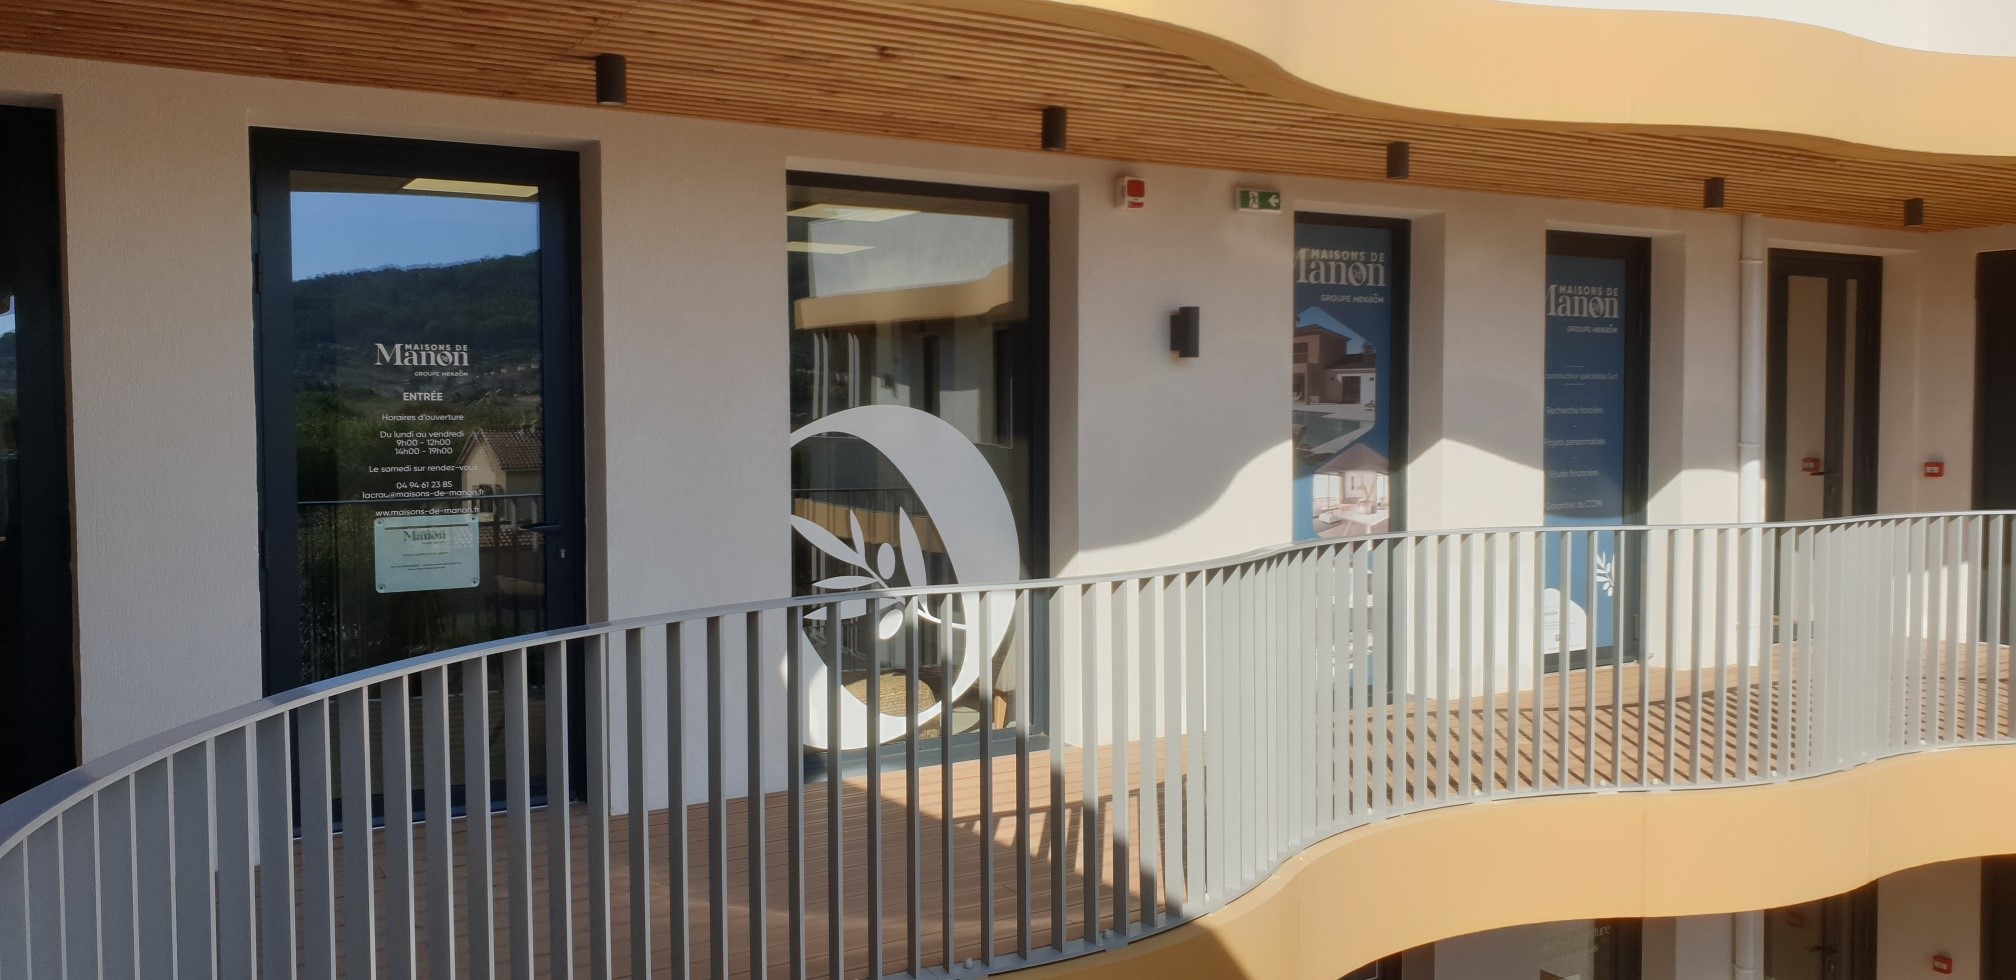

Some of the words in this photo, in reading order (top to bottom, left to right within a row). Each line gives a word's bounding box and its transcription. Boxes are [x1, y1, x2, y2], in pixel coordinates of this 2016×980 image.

[1311, 248, 1365, 262] MAISONS
[1371, 252, 1385, 263] DE
[1560, 285, 1603, 296] MAISONS
[1607, 287, 1618, 297] DE
[1321, 294, 1351, 303] GROUPE
[1567, 325, 1591, 333] GROUPE
[455, 344, 468, 352] DE
[374, 343, 471, 367] Manon
[402, 390, 443, 401] ENTRÉE
[381, 413, 416, 421] Horaires
[417, 413, 465, 421] d'ouverture
[379, 431, 392, 439] Du
[393, 430, 414, 438] lundi
[428, 430, 465, 438] vendredi
[396, 439, 418, 447] 9h00
[394, 447, 419, 455] 14h00
[428, 447, 453, 455] 19h00
[369, 465, 379, 473] Le
[381, 464, 412, 473] samedi
[427, 464, 479, 472] rendez-vous
[396, 481, 408, 489] 04
[409, 481, 420, 489] 94
[421, 481, 429, 489] 61
[362, 488, 485, 499] lacrau@maisons-de-manon.fr
